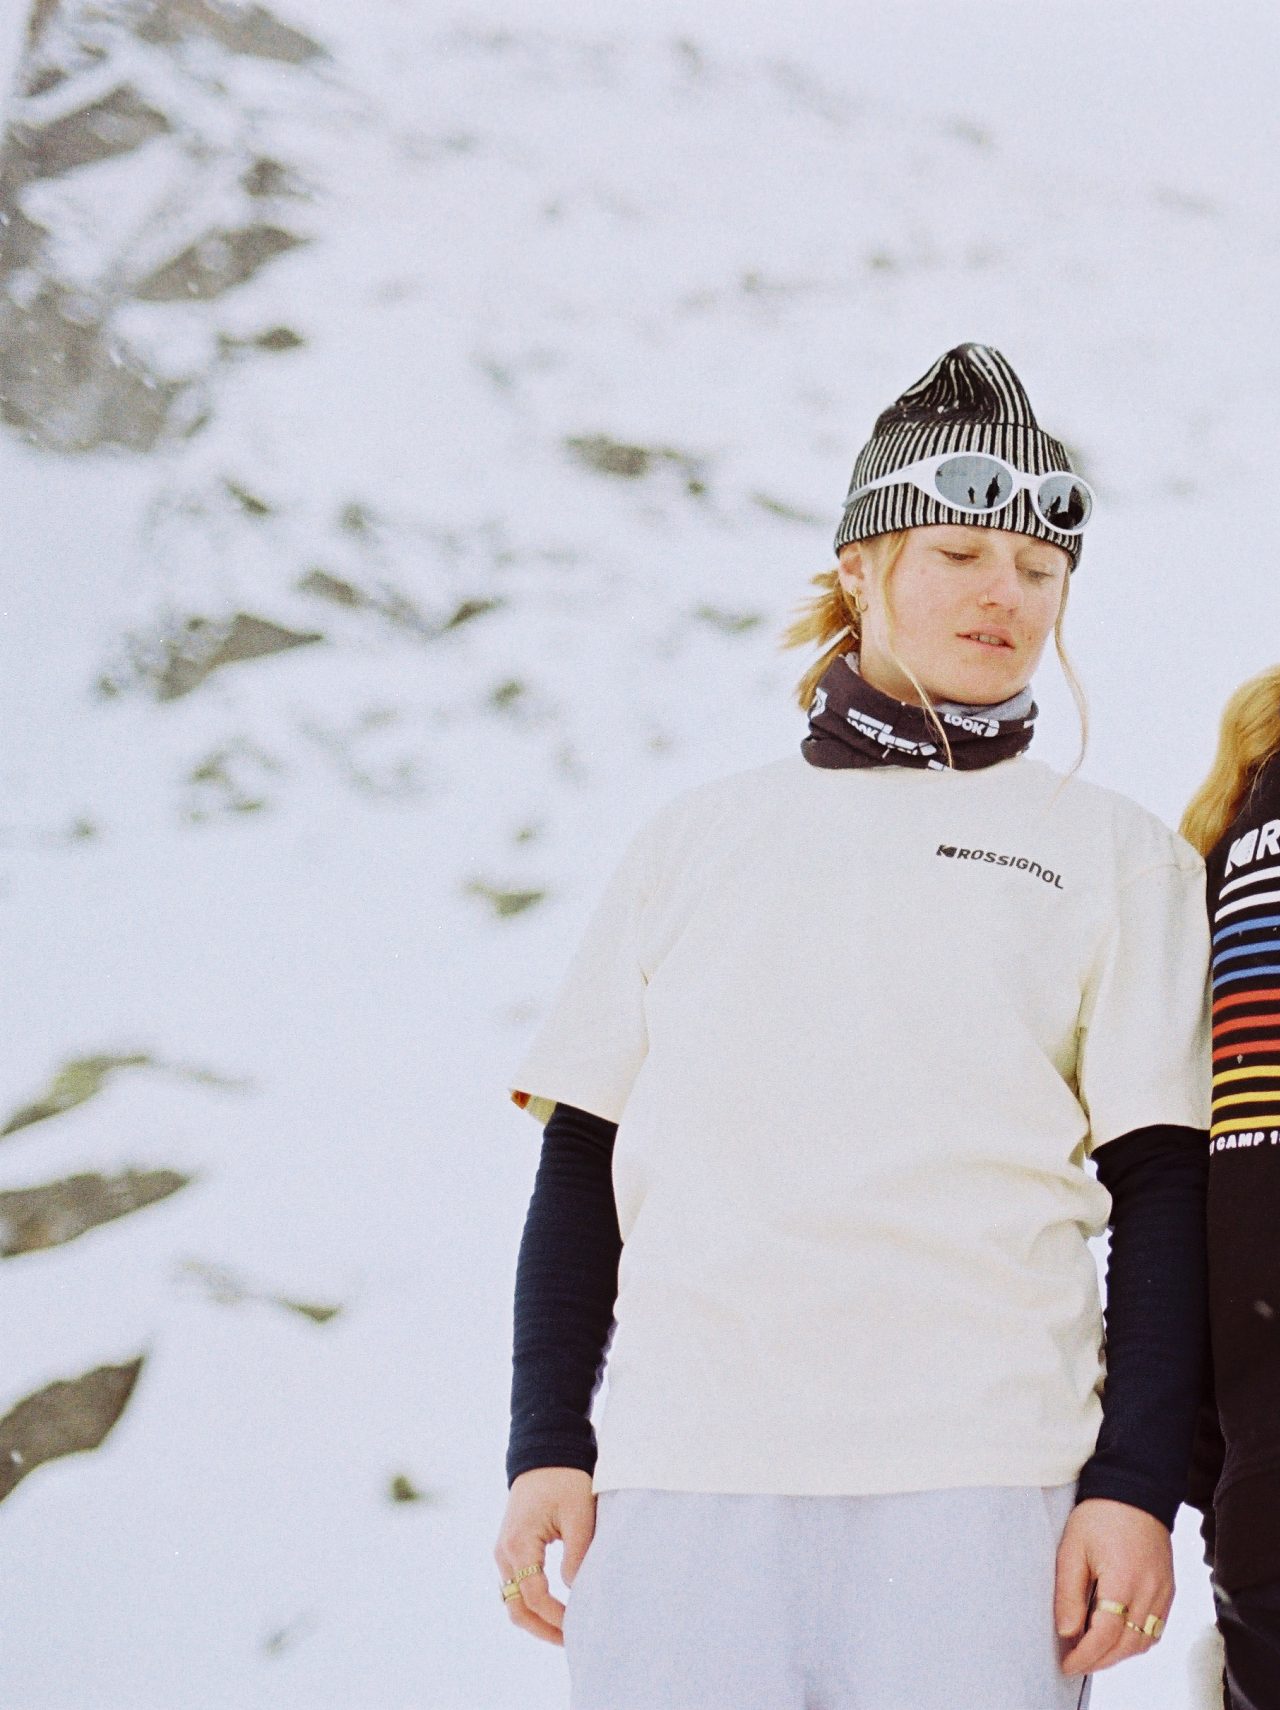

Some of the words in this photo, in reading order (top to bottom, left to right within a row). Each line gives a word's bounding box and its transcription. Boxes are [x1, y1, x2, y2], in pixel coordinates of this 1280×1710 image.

[943, 712, 986, 736] LOOK
[957, 848, 1064, 889] ROSSIGNOL
[1216, 1131, 1265, 1151] CAMP
